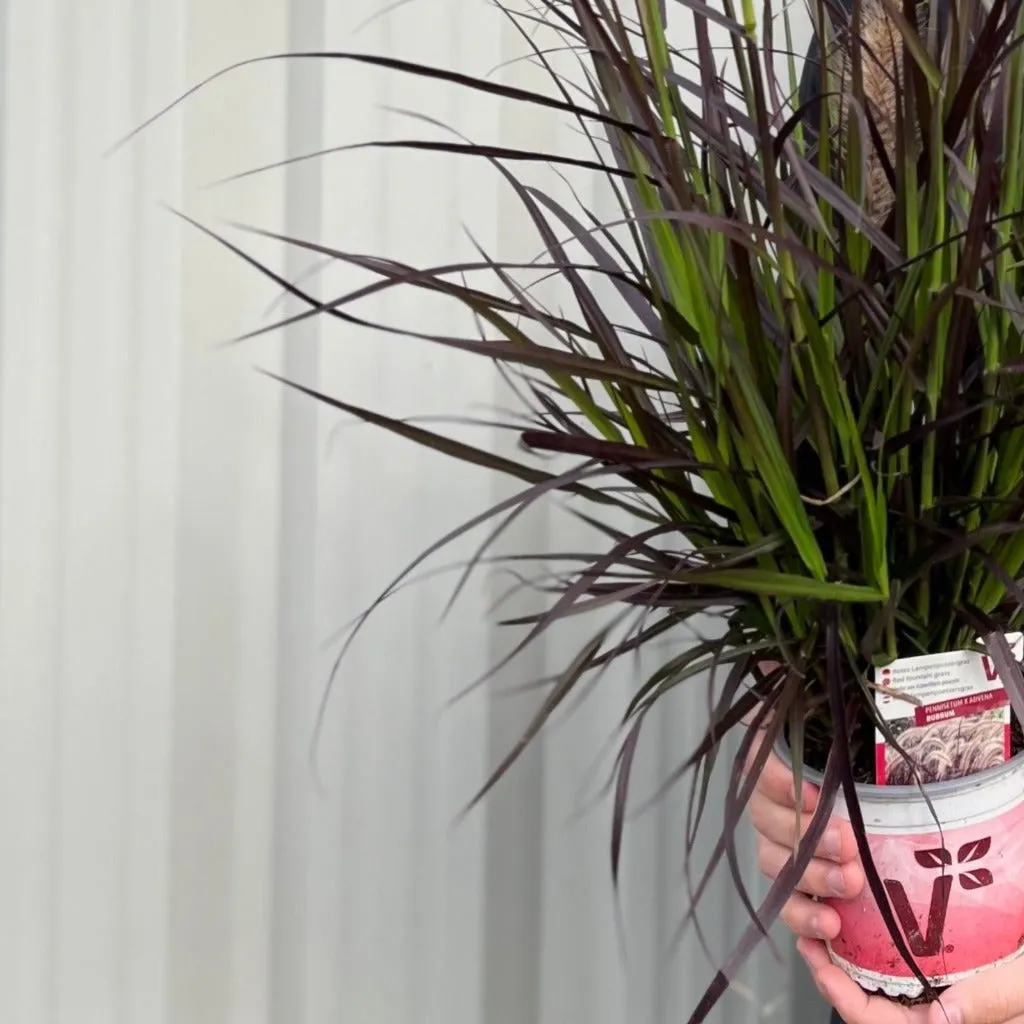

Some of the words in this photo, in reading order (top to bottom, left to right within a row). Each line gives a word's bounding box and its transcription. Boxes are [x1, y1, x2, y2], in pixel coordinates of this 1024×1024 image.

[925, 698, 963, 714] PENNISETUM
[969, 692, 993, 705] ADVENA
[926, 710, 956, 722] RUBRUM
